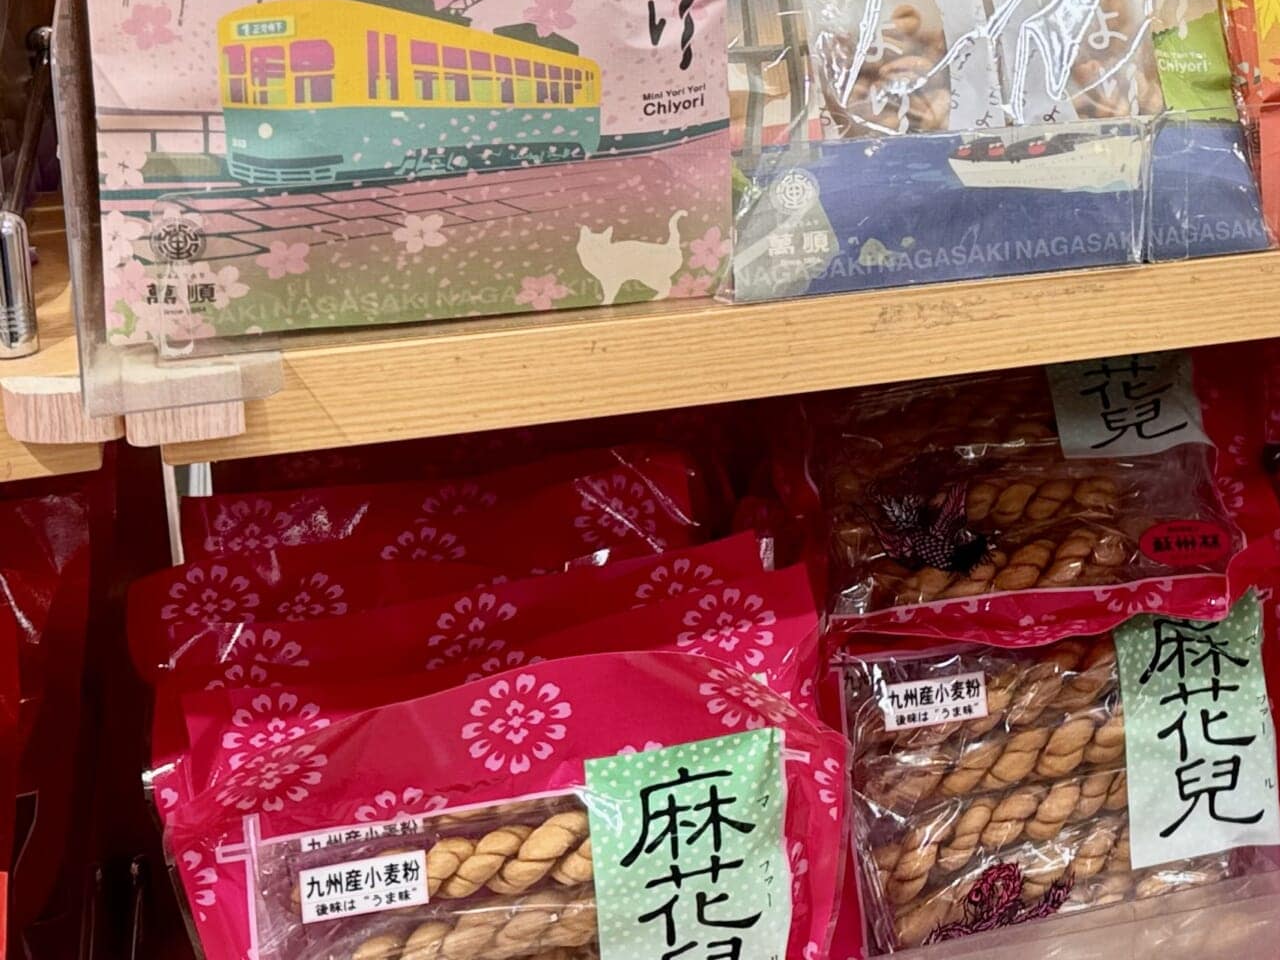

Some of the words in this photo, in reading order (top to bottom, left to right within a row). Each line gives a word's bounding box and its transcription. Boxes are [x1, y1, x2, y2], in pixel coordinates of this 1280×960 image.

[1158, 58, 1209, 74] Chiyori
[643, 92, 663, 101] Mini
[666, 87, 685, 97] Yori
[688, 83, 706, 93] Yori
[643, 93, 705, 117] Chiyori
[879, 242, 1009, 271] NAGASAKI
[888, 677, 981, 710] 九州産小麦粉
[1138, 617, 1265, 838] 麻花兒
[307, 859, 421, 899] 九州産小麦粉
[620, 767, 762, 960] 麻花
